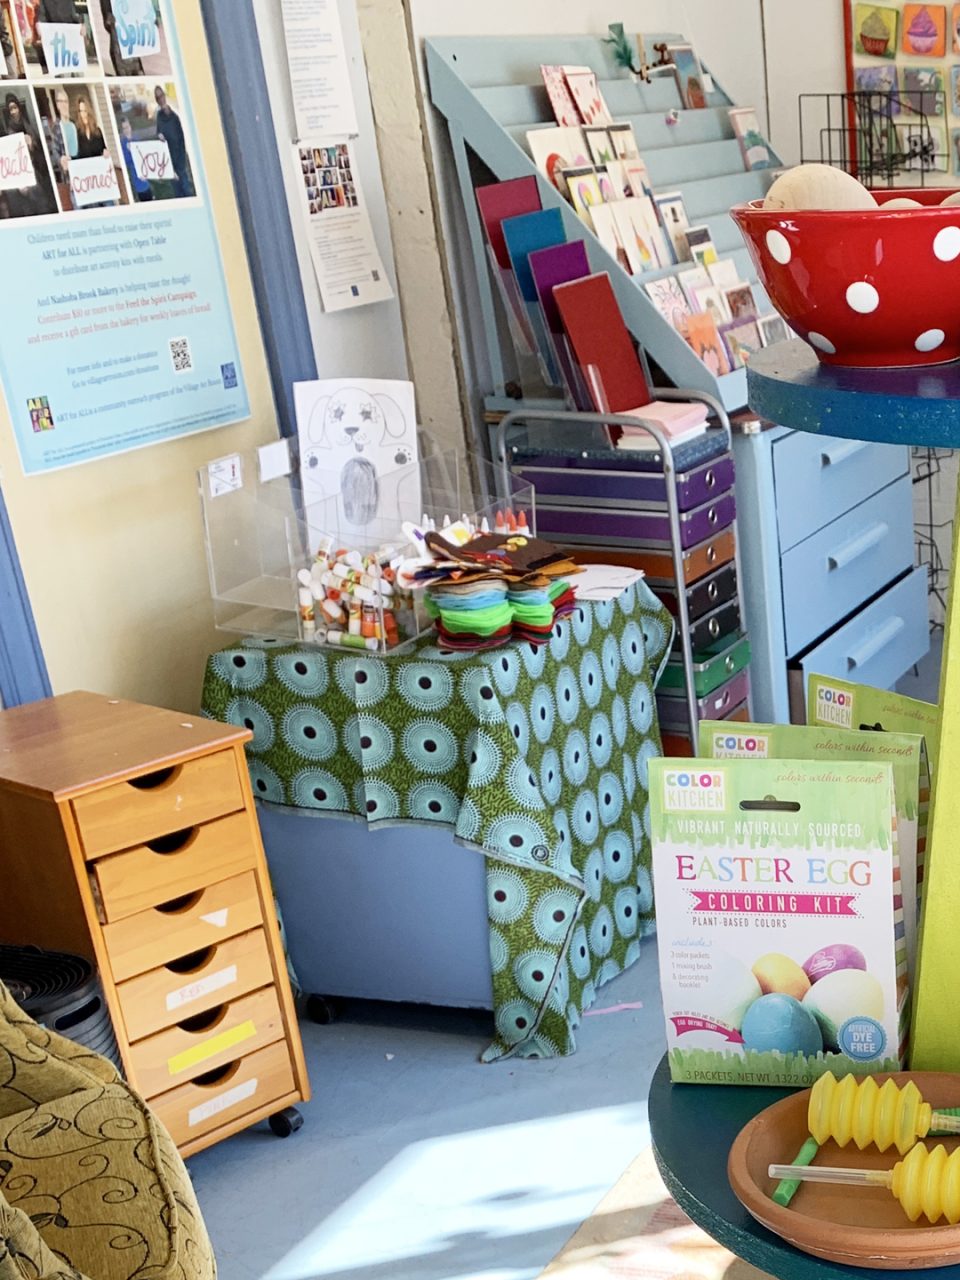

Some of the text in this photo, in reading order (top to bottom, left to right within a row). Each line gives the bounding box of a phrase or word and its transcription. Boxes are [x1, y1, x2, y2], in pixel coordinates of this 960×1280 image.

[51, 31, 79, 67] the
[0, 143, 32, 180] reate
[72, 167, 118, 193] connect
[818, 688, 852, 707] COLOR
[818, 703, 851, 725] KITCHEN
[715, 737, 765, 751] COLOR
[815, 741, 914, 756] colors within seconds
[666, 774, 721, 787] COLOR
[776, 772, 884, 785] colors within seconds
[668, 790, 723, 809] KITCHEN
[677, 820, 861, 838] VIBRANT NATURALLY SOURCED
[675, 855, 872, 887] EASTER EGG
[708, 894, 842, 913] COLORING KIT
[693, 917, 787, 929] PLANT-BASED COLORS
[853, 1033, 873, 1043] DYE
[850, 1043, 876, 1053] FREE
[686, 1070, 692, 1079] 3
[738, 1072, 755, 1082] NET
